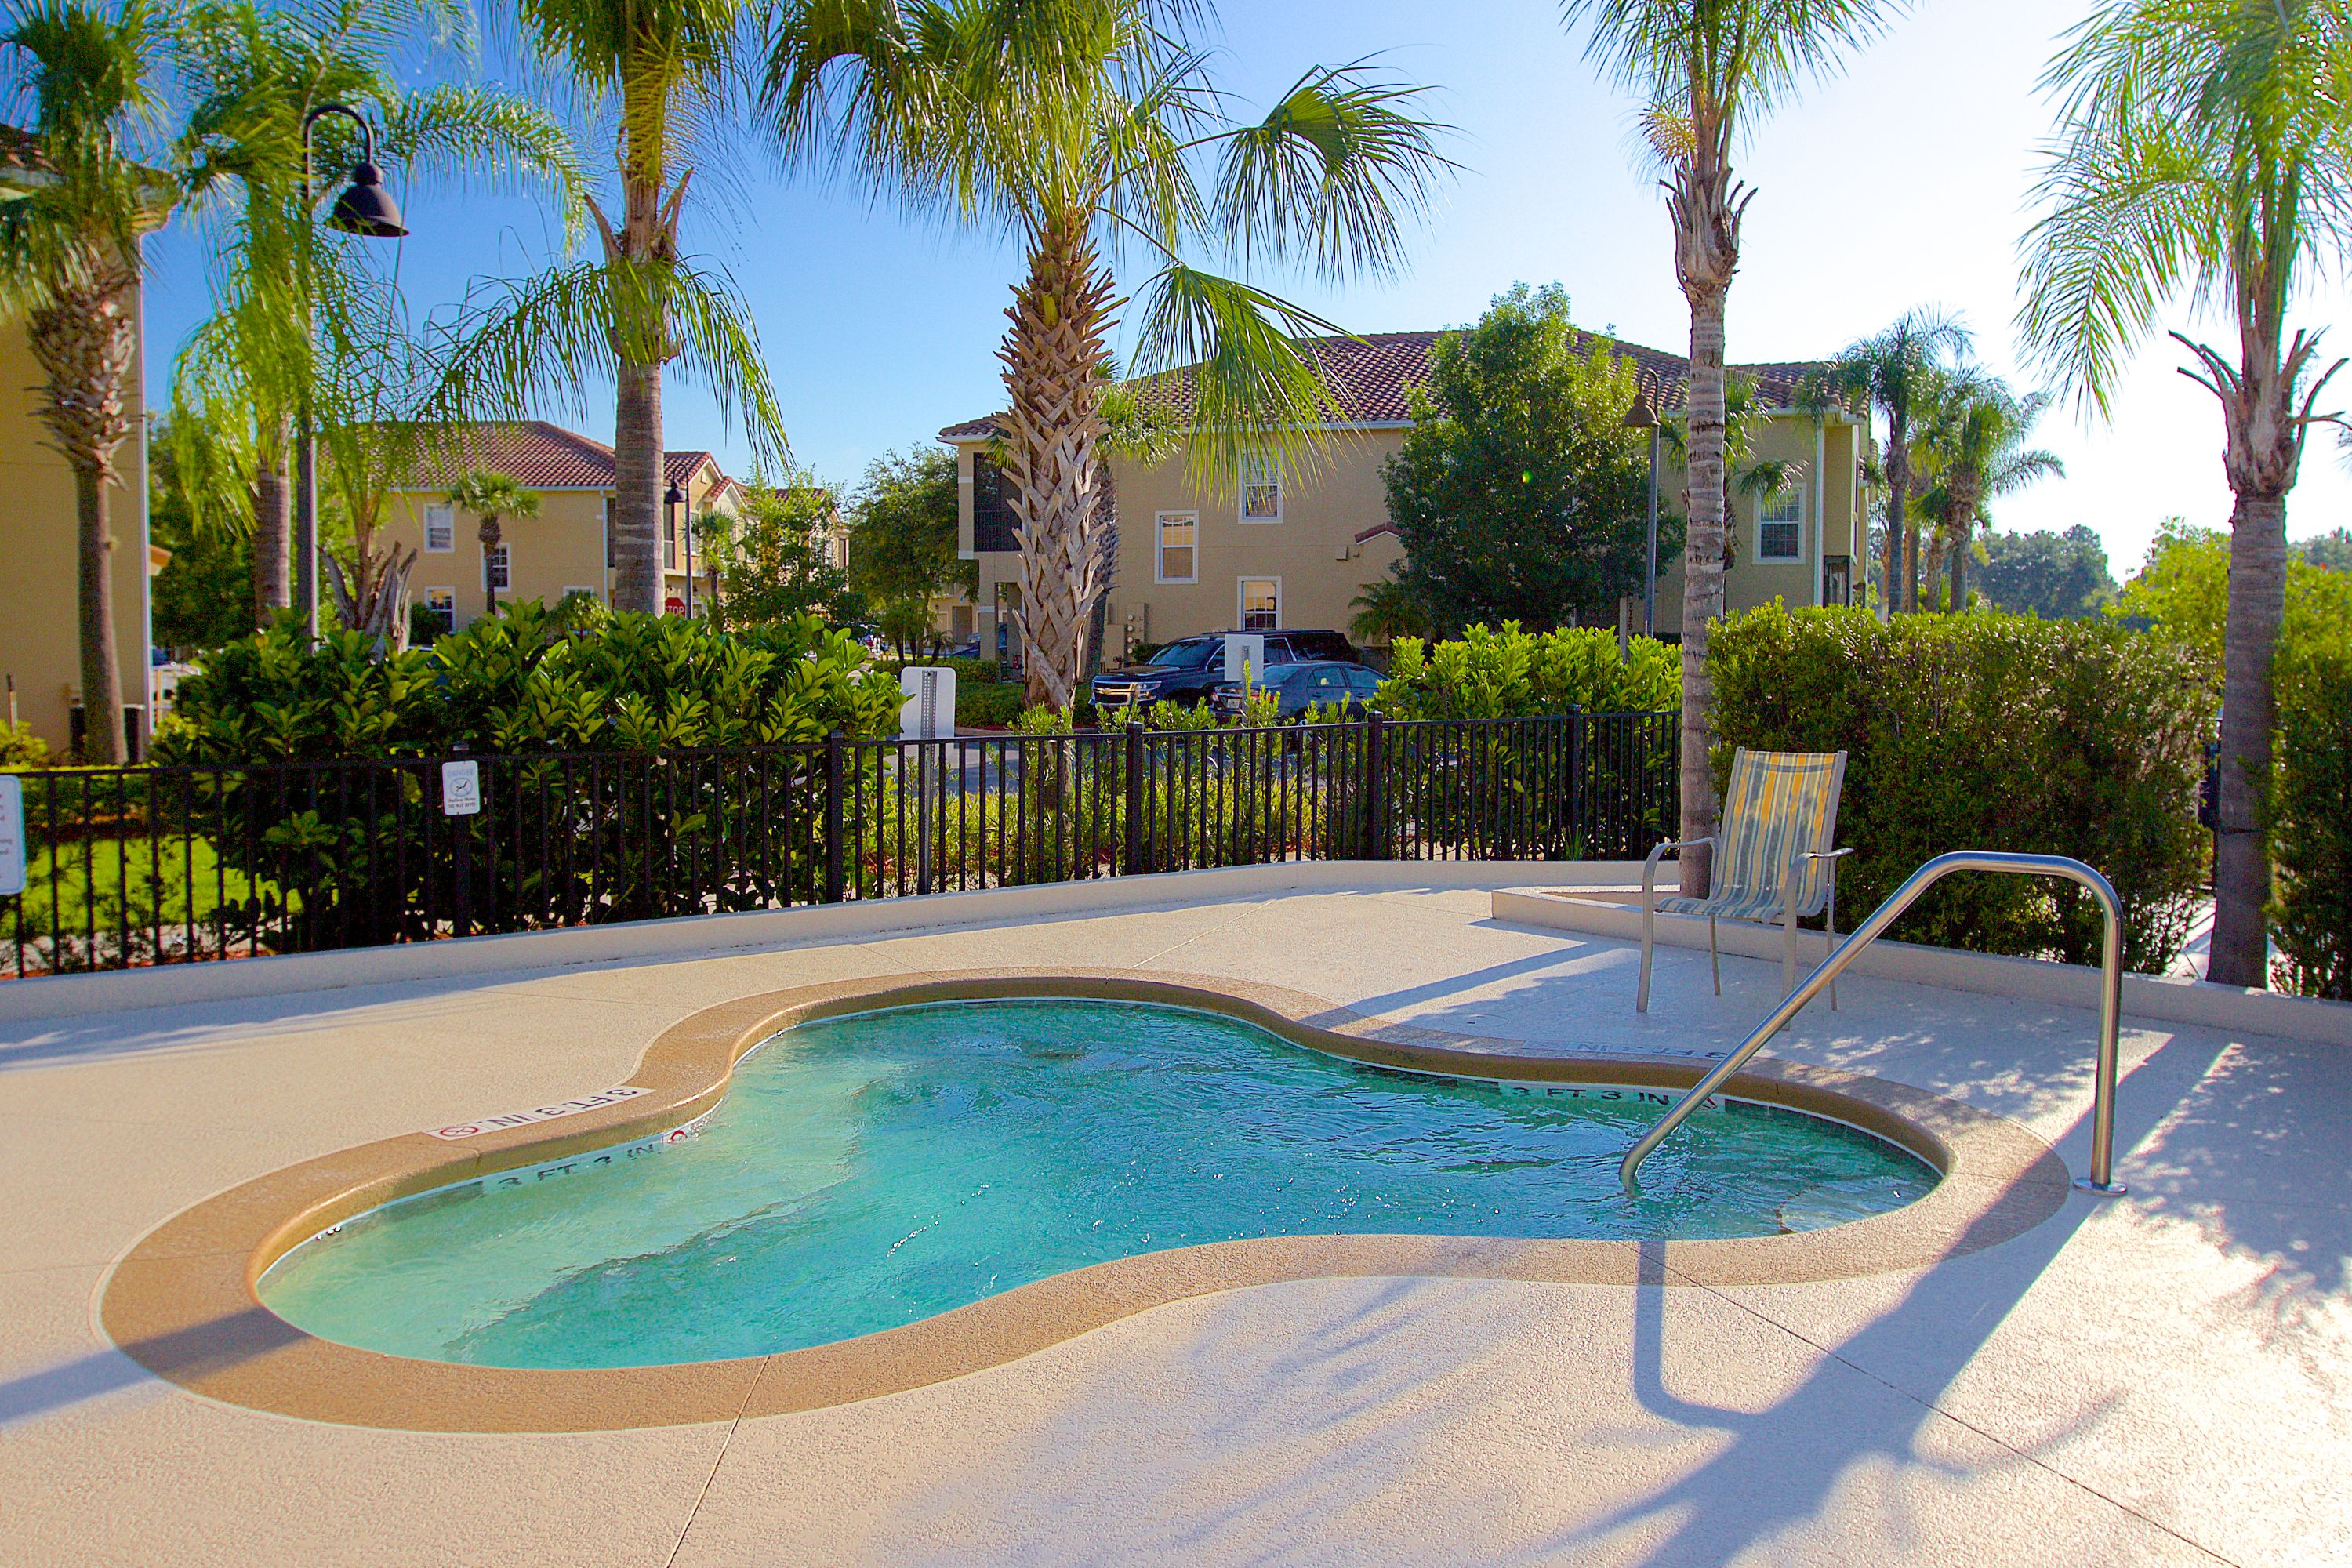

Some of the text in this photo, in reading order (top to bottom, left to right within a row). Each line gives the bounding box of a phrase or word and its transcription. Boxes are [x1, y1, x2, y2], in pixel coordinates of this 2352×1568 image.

[665, 605, 684, 616] TOP
[1601, 1091, 1623, 1100] 3
[535, 1107, 566, 1116] 3
